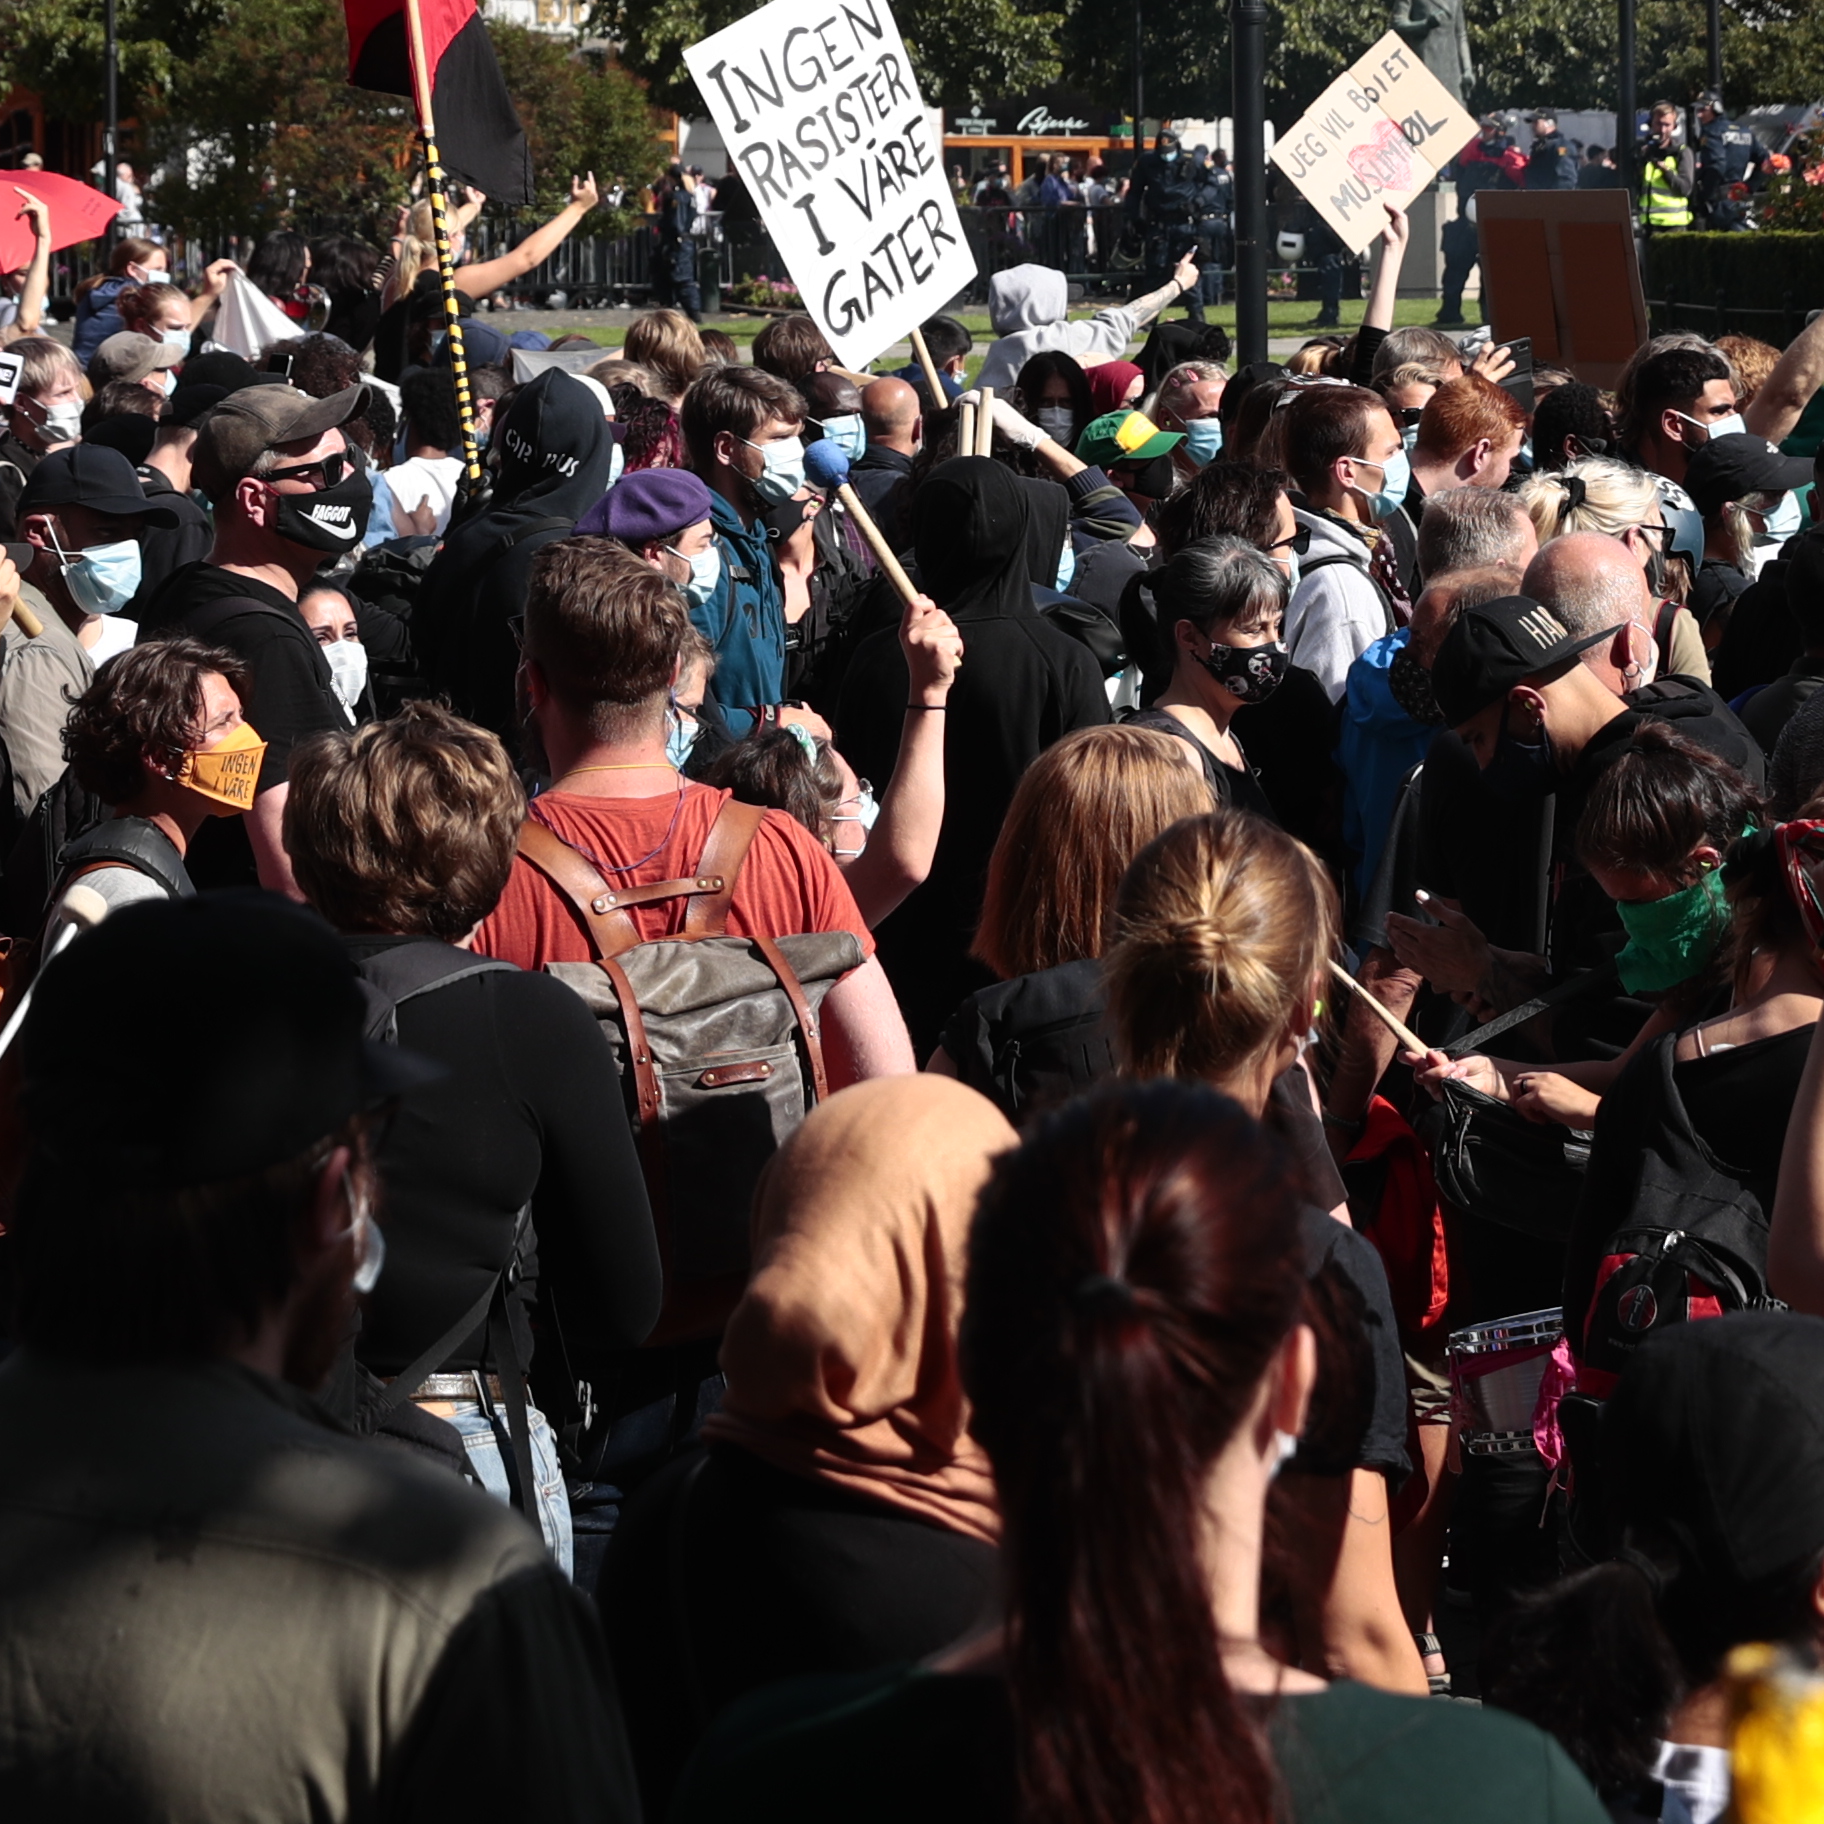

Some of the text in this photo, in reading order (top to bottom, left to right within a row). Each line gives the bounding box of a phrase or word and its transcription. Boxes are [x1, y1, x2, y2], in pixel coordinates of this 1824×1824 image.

[738, 52, 912, 207] RASISTER
[1016, 105, 1091, 135] Bjerke
[1291, 132, 1328, 180] JEG
[1320, 108, 1355, 141] VIL
[793, 192, 837, 257] I
[822, 199, 957, 337] GATER
[311, 503, 352, 524] FAGGOT
[220, 751, 259, 776] INGEN
[223, 776, 252, 801] VÅRE
[1628, 1288, 1647, 1327] NTL
